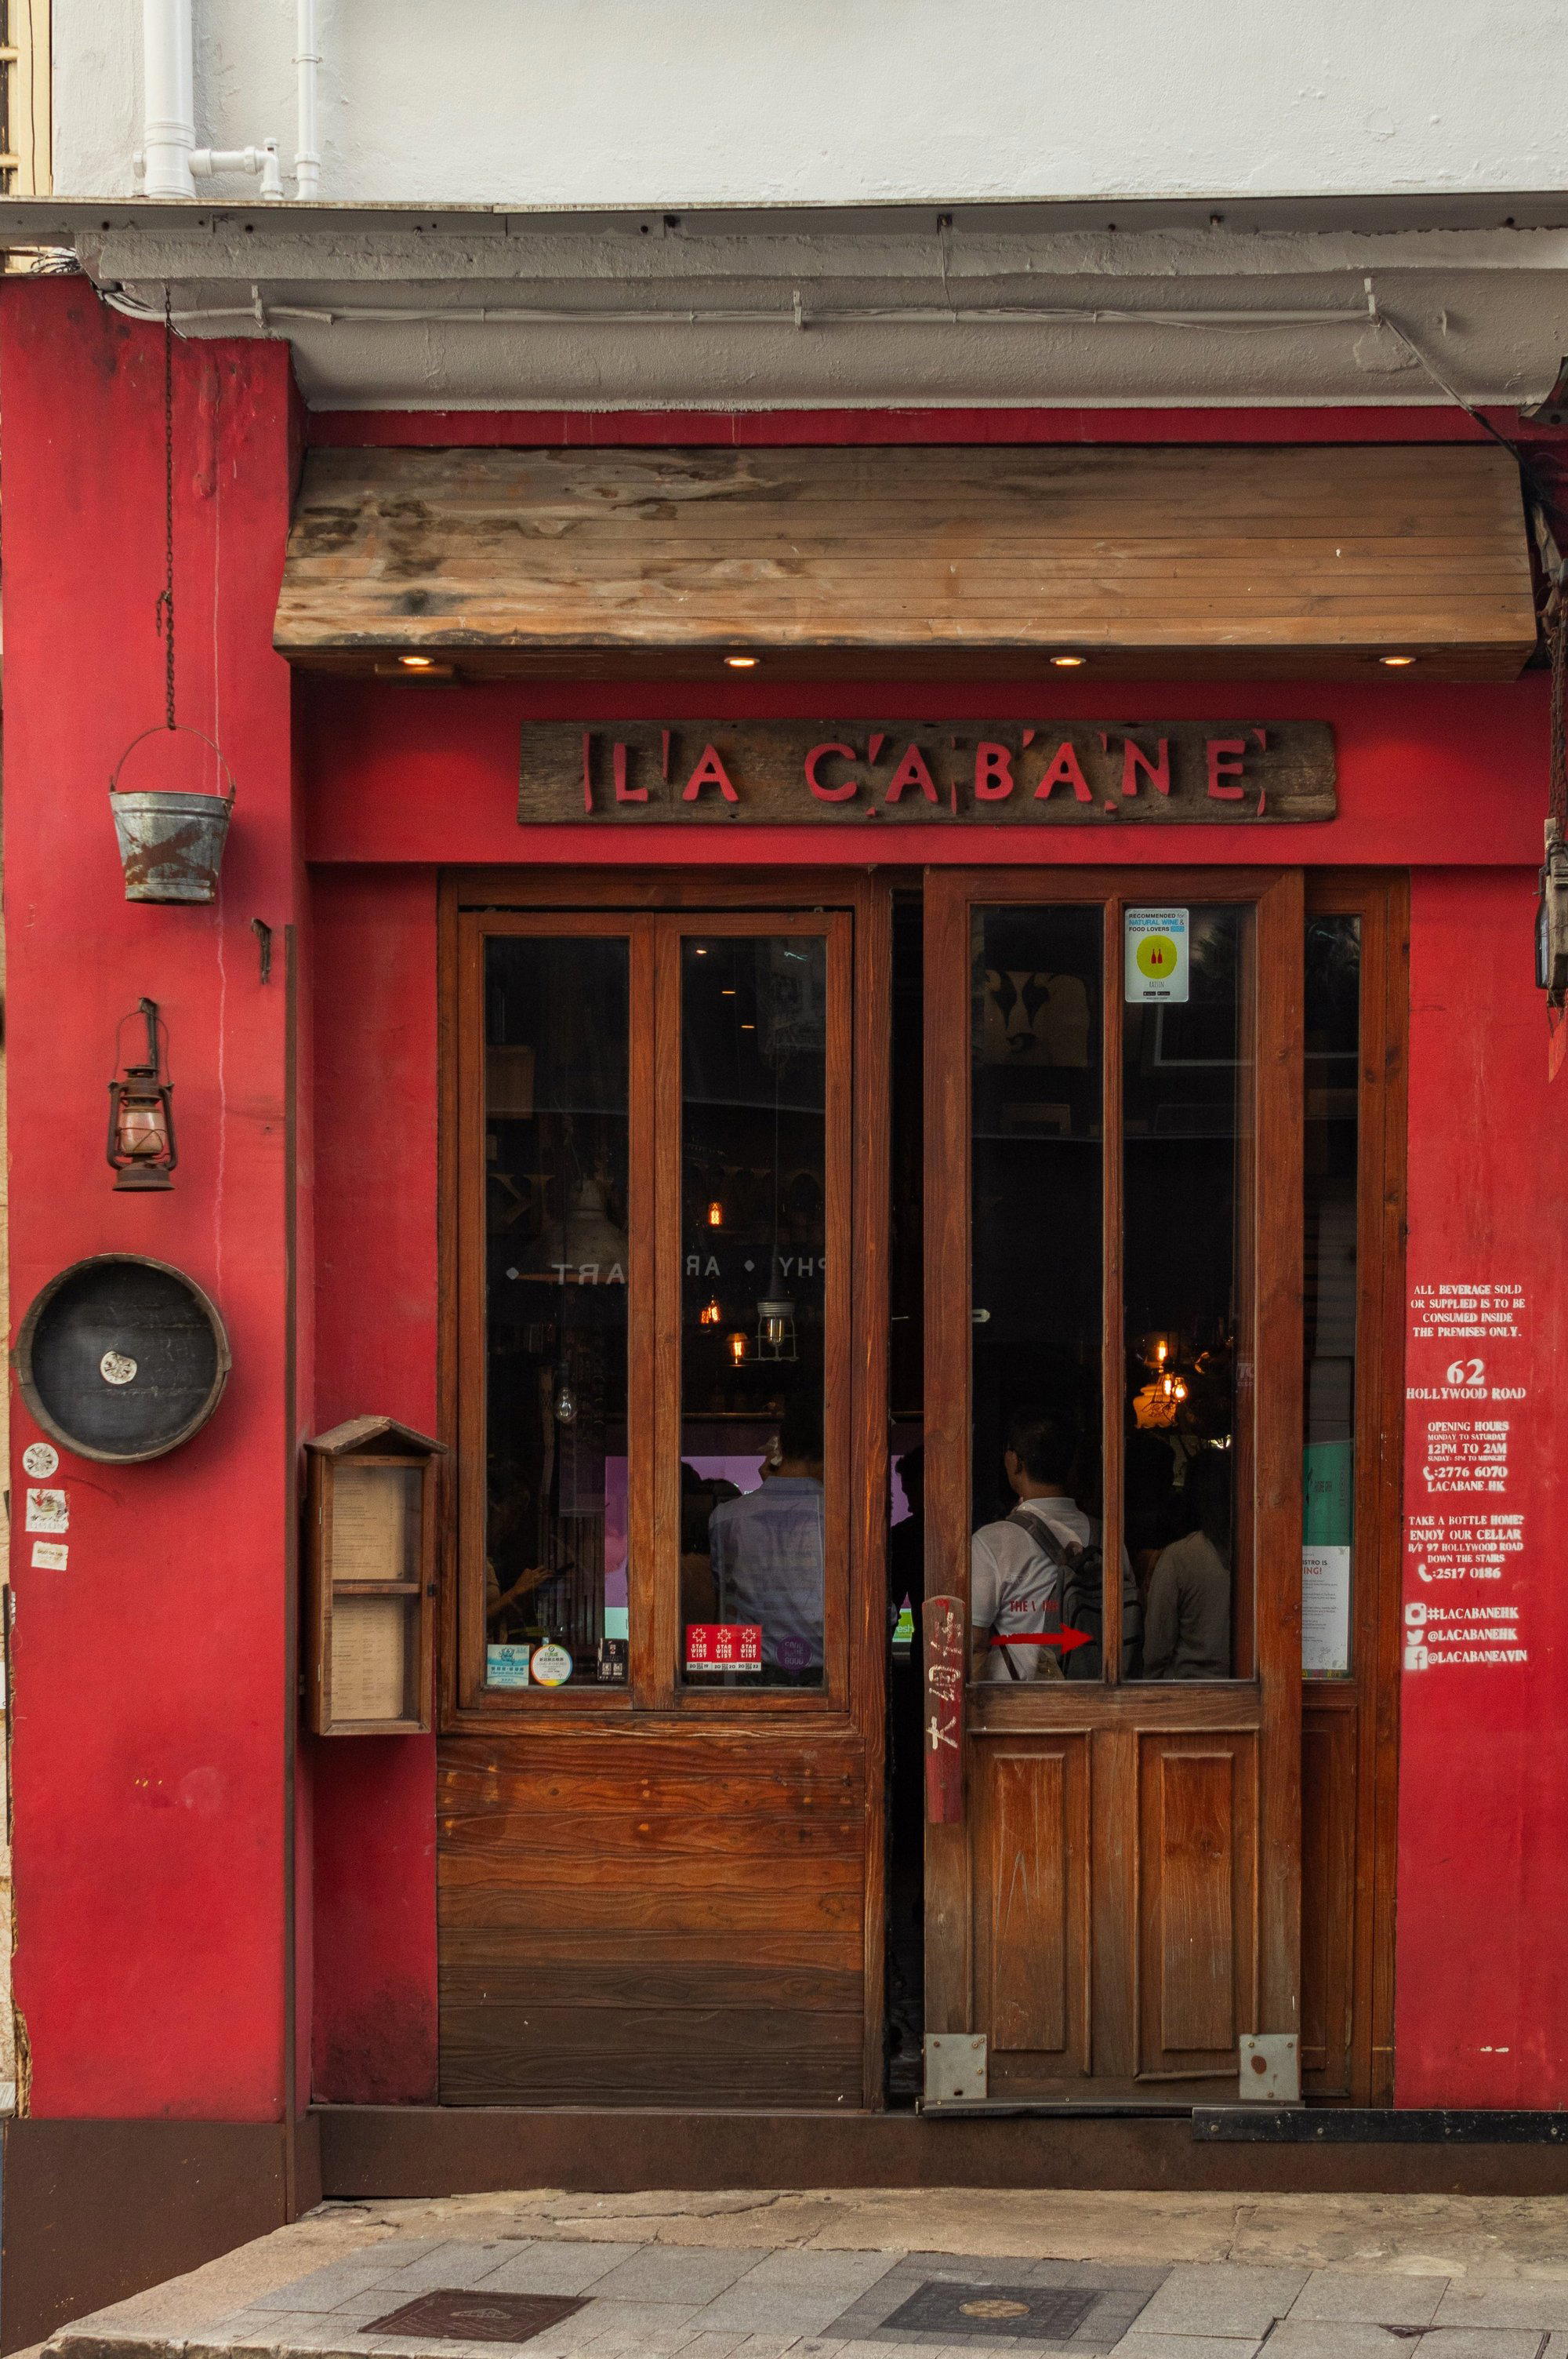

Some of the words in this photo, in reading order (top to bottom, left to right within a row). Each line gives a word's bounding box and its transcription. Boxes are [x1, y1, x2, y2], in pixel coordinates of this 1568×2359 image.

[1414, 1285, 1435, 1295] ALL
[1439, 1285, 1491, 1295] BEVERAGE
[1494, 1285, 1522, 1295] SOLD
[1411, 1299, 1425, 1308] OR
[1429, 1299, 1477, 1308] SUPPLIED
[1480, 1299, 1490, 1308] IS
[1494, 1299, 1509, 1308] TO
[1513, 1299, 1526, 1308] BE
[1422, 1313, 1477, 1322] CONSUMED
[1481, 1313, 1513, 1322] INSIDE
[1413, 1327, 1434, 1337] THE
[1438, 1327, 1486, 1337] PREMISES
[1490, 1327, 1522, 1337] ONLY.
[1446, 1358, 1486, 1385] 62
[1406, 1387, 1487, 1400] HOLLYWOOD
[1492, 1387, 1526, 1400] ROAD
[1428, 1421, 1471, 1431] OPENING
[1475, 1421, 1509, 1431] HOURS
[1428, 1443, 1457, 1454] 12PM
[1462, 1443, 1479, 1454] TO
[1483, 1443, 1507, 1454] 2AM
[1475, 1467, 1508, 1478] 6070
[1409, 1515, 1435, 1525] TAKE
[1438, 1515, 1445, 1525] A
[1449, 1515, 1487, 1525] BOTTLE
[1490, 1515, 1525, 1525] HOME?
[1410, 1529, 1445, 1540] ENJOY
[1450, 1529, 1472, 1540] OUR
[1477, 1529, 1522, 1540] CELLAR
[1408, 1543, 1424, 1552] B/F
[1426, 1543, 1439, 1552] 97
[1442, 1543, 1497, 1552] HOLLYWOOD
[1499, 1543, 1524, 1552] ROAD
[1428, 1554, 1453, 1563] DOWN
[1456, 1554, 1473, 1563] THE
[1475, 1554, 1505, 1563] STAIRS
[1469, 1568, 1501, 1579] 0186
[1427, 1607, 1519, 1621] #LACABANEHK
[1428, 1628, 1518, 1642] @LACABANEHK
[1428, 1649, 1527, 1664] @LACABANEAVIN
